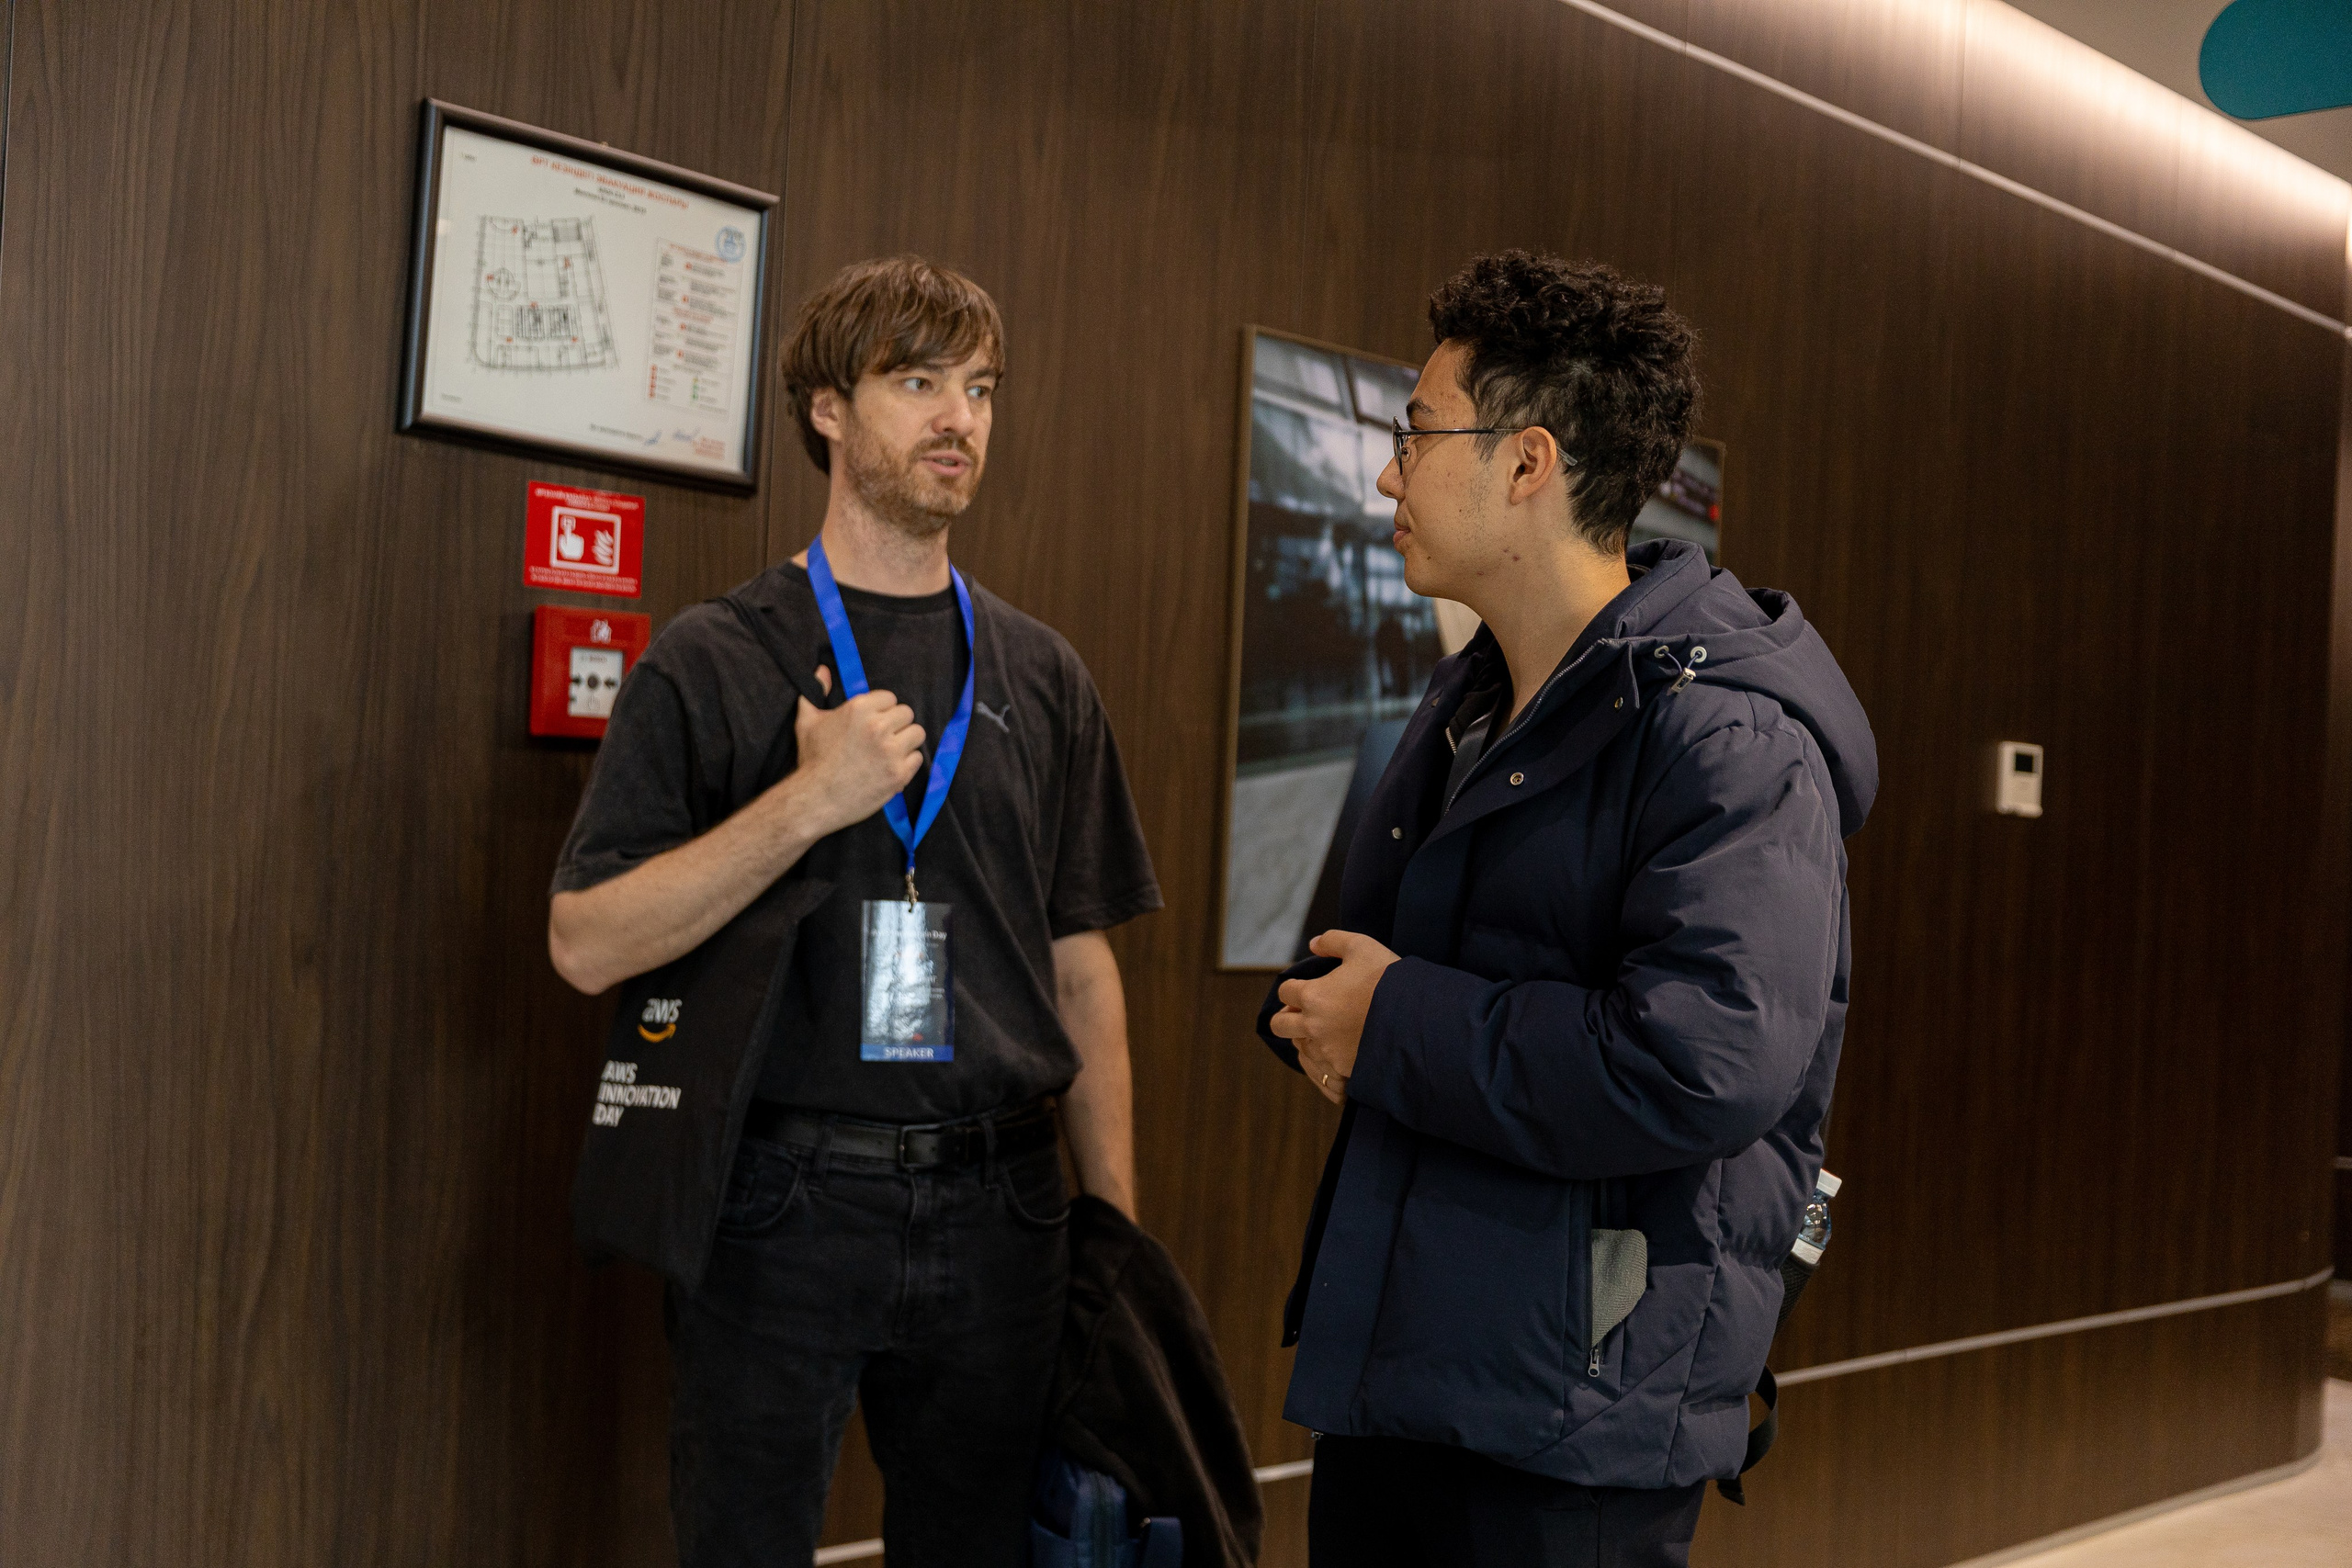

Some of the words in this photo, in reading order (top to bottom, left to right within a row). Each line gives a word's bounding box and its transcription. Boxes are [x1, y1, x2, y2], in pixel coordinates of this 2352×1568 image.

[642, 998, 683, 1024] aws
[884, 1046, 934, 1059] SPEAKER
[601, 1059, 639, 1085] AWS
[597, 1080, 682, 1110] INNOVATION
[592, 1102, 625, 1127] DAY
